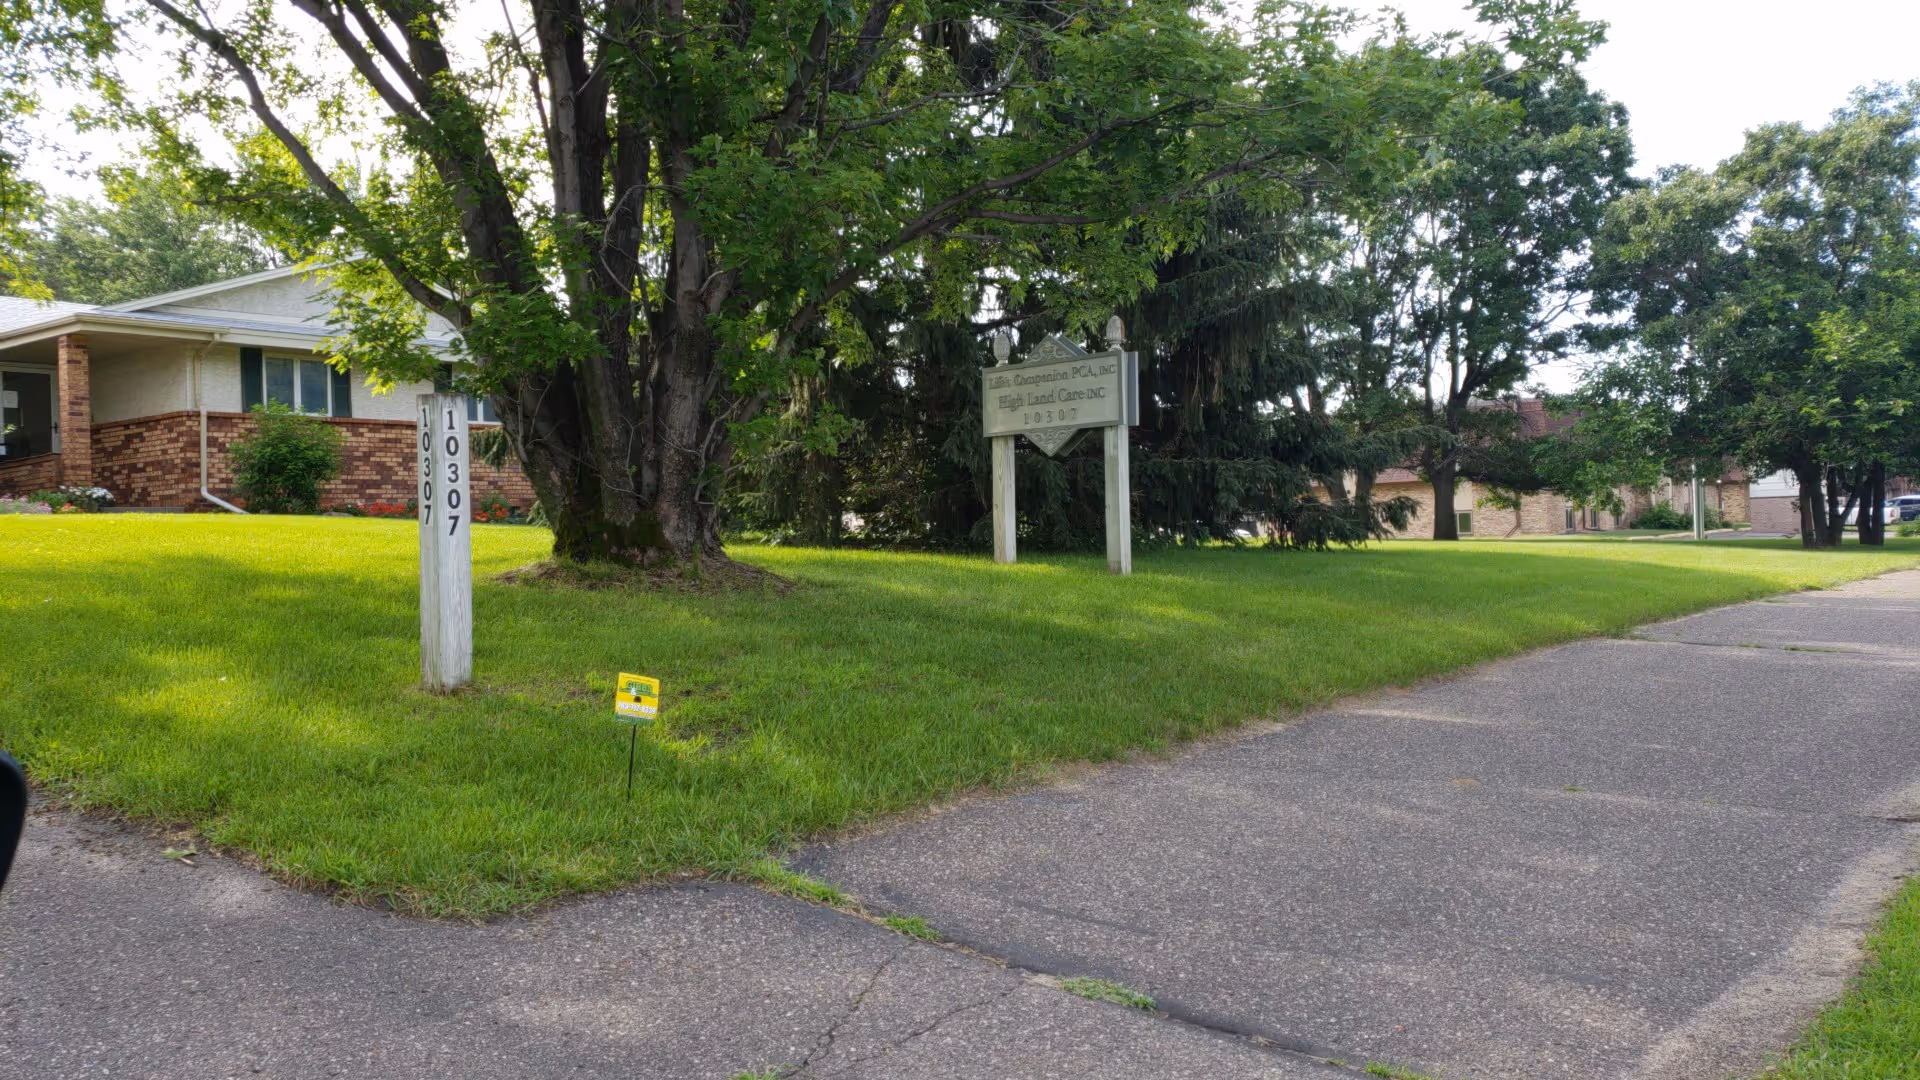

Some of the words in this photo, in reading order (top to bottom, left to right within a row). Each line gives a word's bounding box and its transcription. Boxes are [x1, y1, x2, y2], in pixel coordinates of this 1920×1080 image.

[999, 393, 1024, 411] High
[1028, 389, 1056, 406] Land
[1058, 388, 1084, 403] Care
[1087, 386, 1105, 399] INC
[1013, 370, 1068, 387] Companion
[1099, 364, 1116, 375] INC
[422, 407, 431, 525] 10307
[446, 409, 460, 536] 10307
